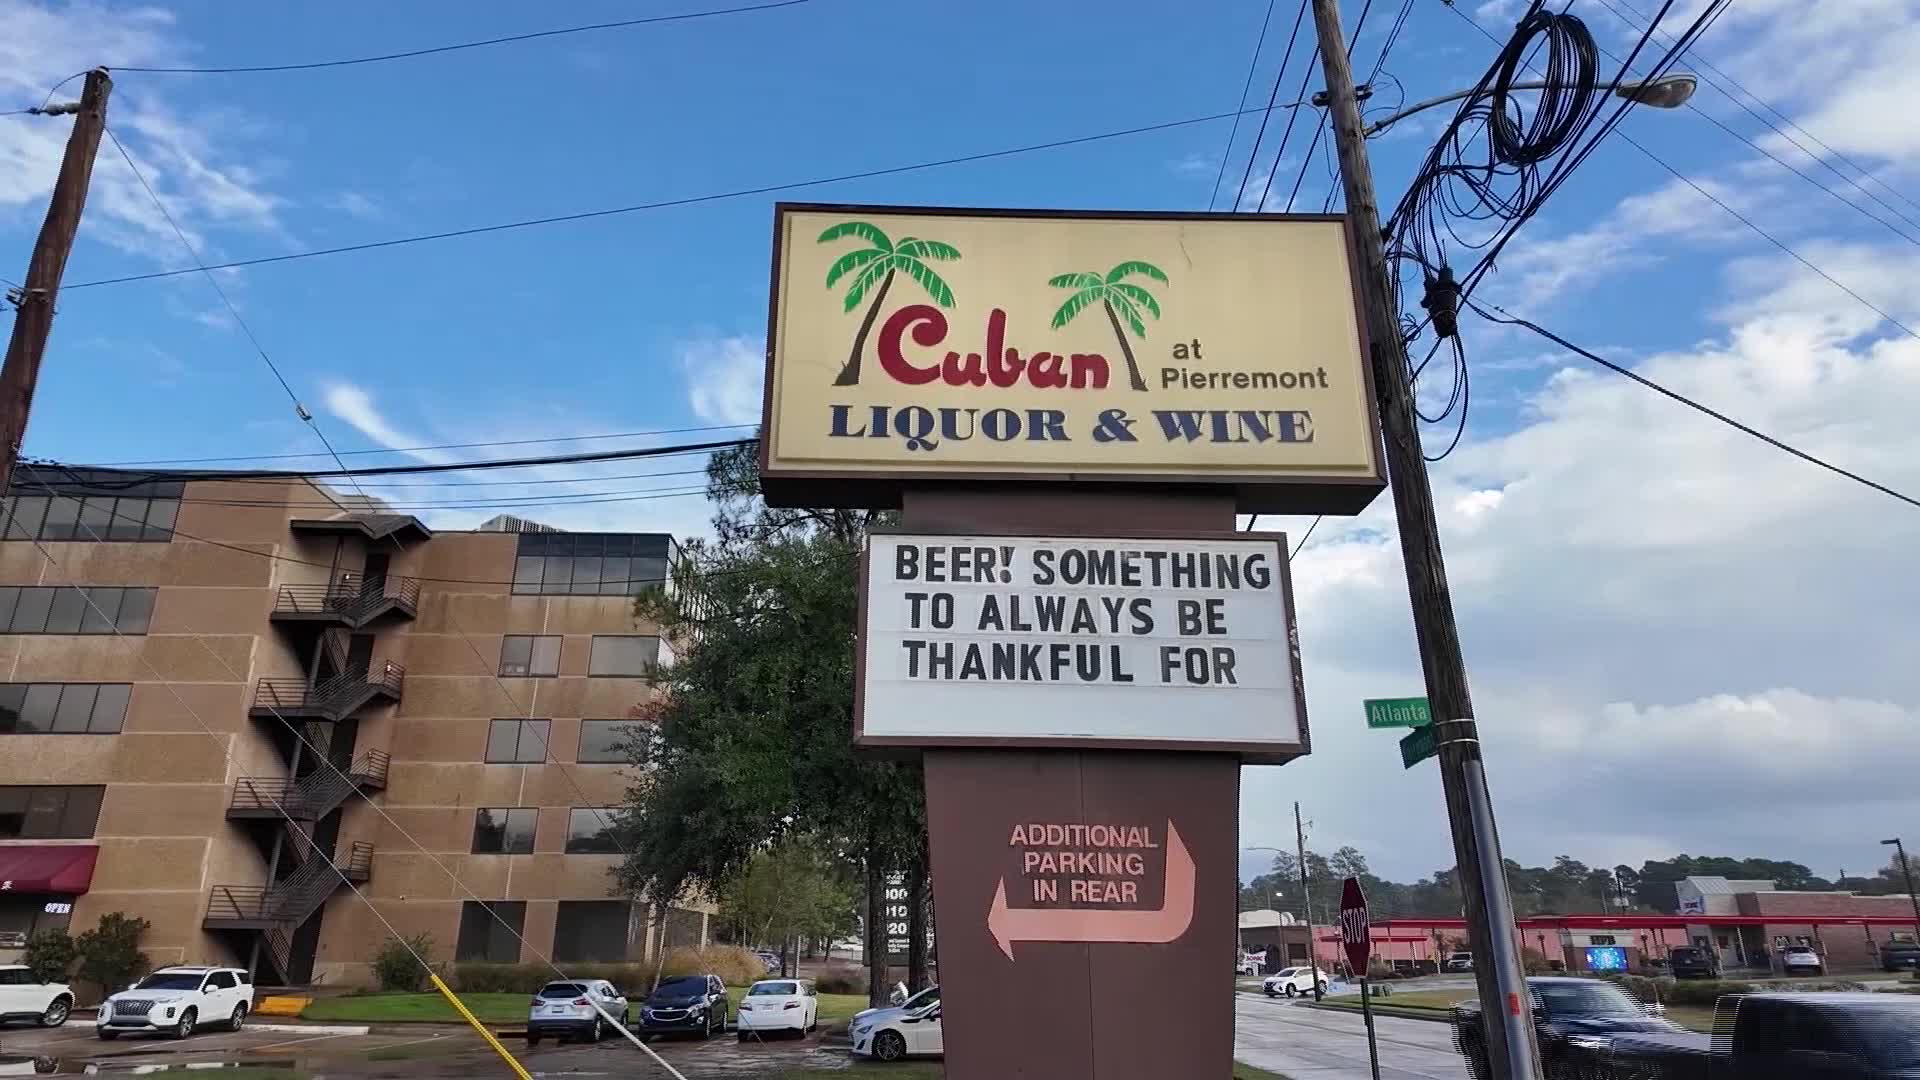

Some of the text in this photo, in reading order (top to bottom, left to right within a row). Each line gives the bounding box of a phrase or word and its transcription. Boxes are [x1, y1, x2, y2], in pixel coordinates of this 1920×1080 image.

[878, 305, 1110, 389] Cuban
[1173, 339, 1202, 360] at
[1161, 367, 1329, 390] Pierremont
[828, 404, 1315, 451] LIQUOR & WINE
[896, 545, 1271, 589] BEER! SOMETHING
[905, 592, 1228, 636] TO ALWAYS BE
[902, 641, 1238, 685] THANKFUL FOR
[1372, 703, 1427, 722] Atlanta
[1010, 824, 1159, 848] ADDITIONAL
[1024, 851, 1145, 875] PARKING
[1034, 879, 1138, 903] IN REAR
[45, 902, 71, 913] OPEN
[1342, 907, 1366, 944] STOP
